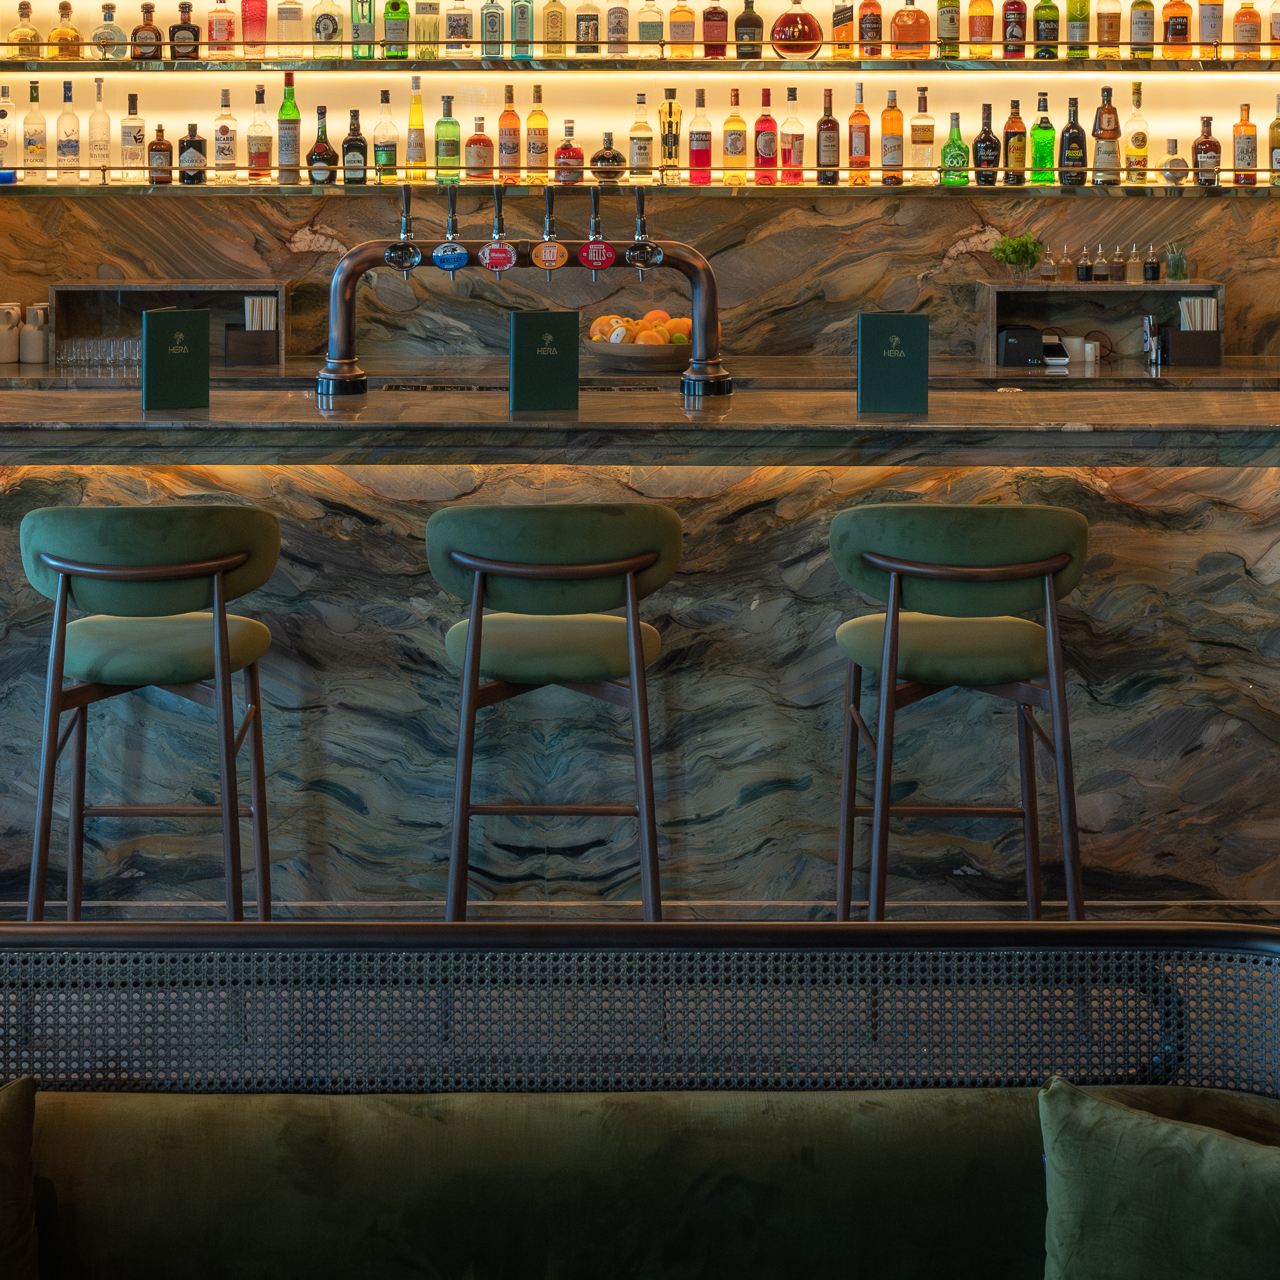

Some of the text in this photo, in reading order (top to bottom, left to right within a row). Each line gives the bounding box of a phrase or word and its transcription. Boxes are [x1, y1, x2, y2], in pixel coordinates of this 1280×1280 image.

[882, 143, 902, 158] Suze
[588, 249, 606, 261] HELLS
[537, 347, 558, 355] HERA
[883, 349, 906, 357] HERA
